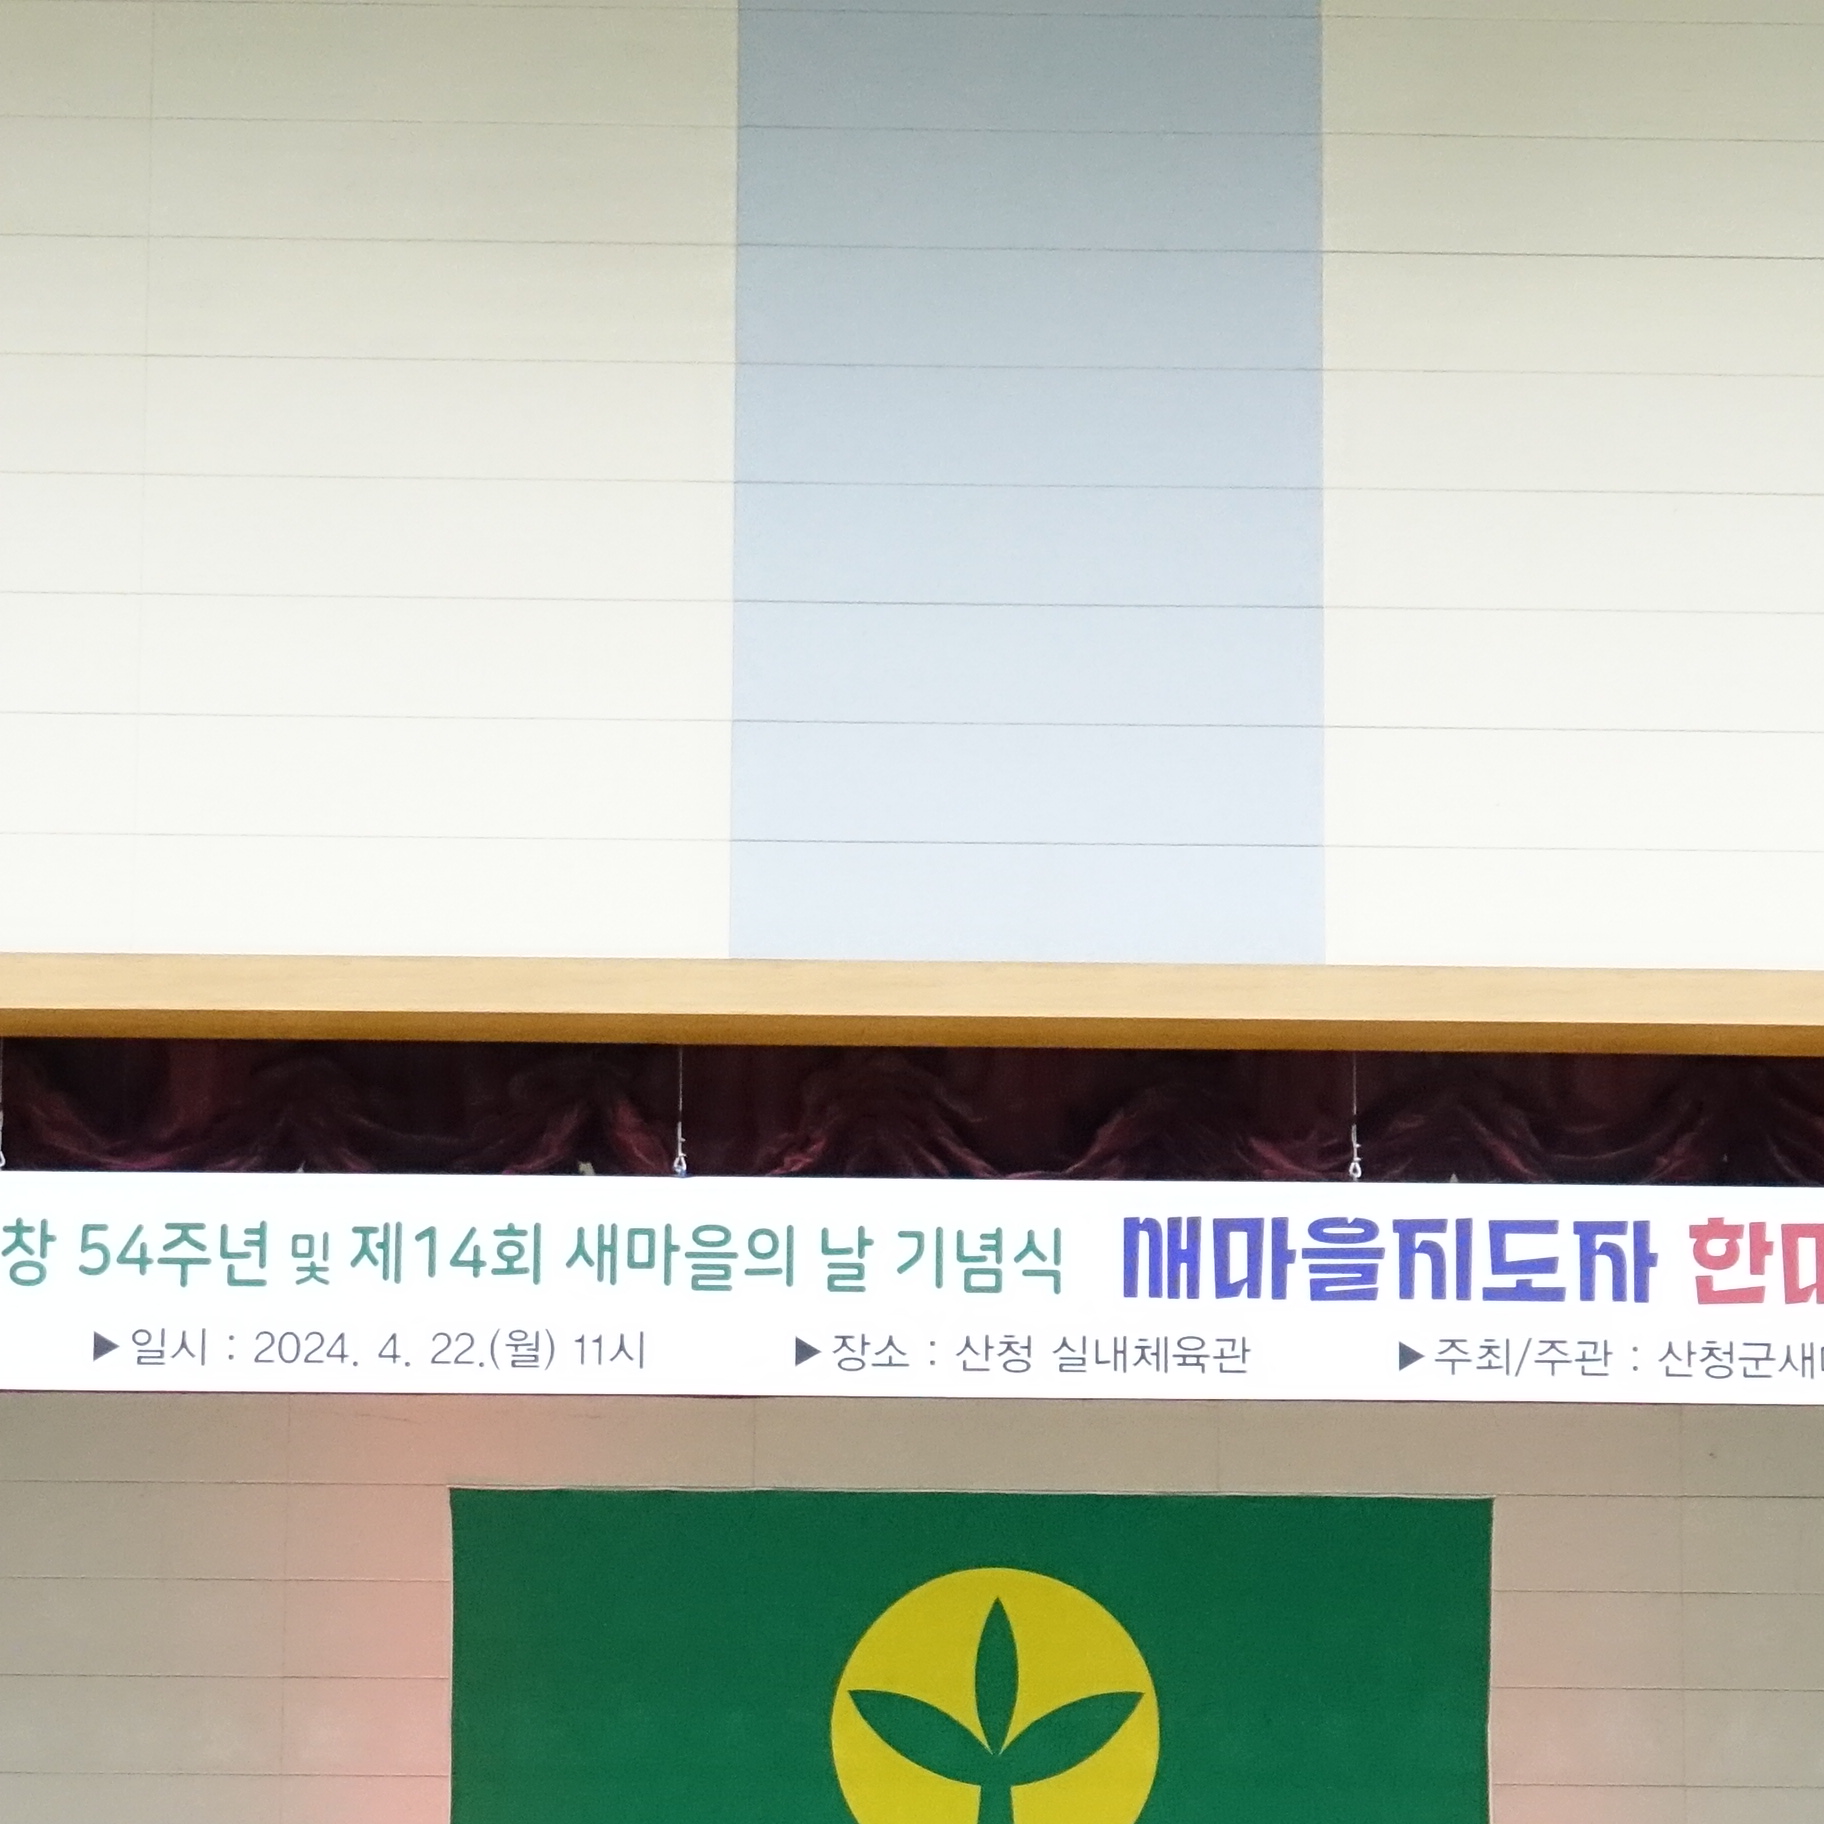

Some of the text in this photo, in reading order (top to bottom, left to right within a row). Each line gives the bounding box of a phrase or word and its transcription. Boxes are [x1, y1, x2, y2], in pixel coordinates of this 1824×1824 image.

[77, 1219, 268, 1289] 54주년
[290, 1230, 331, 1286] 및
[349, 1220, 542, 1287] 제14회
[564, 1222, 795, 1293] 새마을의
[820, 1224, 875, 1294] 날
[895, 1225, 1063, 1296] 기념식
[1122, 1215, 1659, 1305] 새마을지도자
[130, 1327, 207, 1367] 일시
[253, 1329, 359, 1368] 2024.
[377, 1331, 412, 1368] 4.
[429, 1327, 556, 1371] 22.(월)
[573, 1330, 645, 1370] 11시
[831, 1332, 911, 1373] 장소
[954, 1333, 1033, 1375] 산청
[1051, 1334, 1252, 1375] 실내체육관
[1431, 1336, 1614, 1378] 주최/주관
